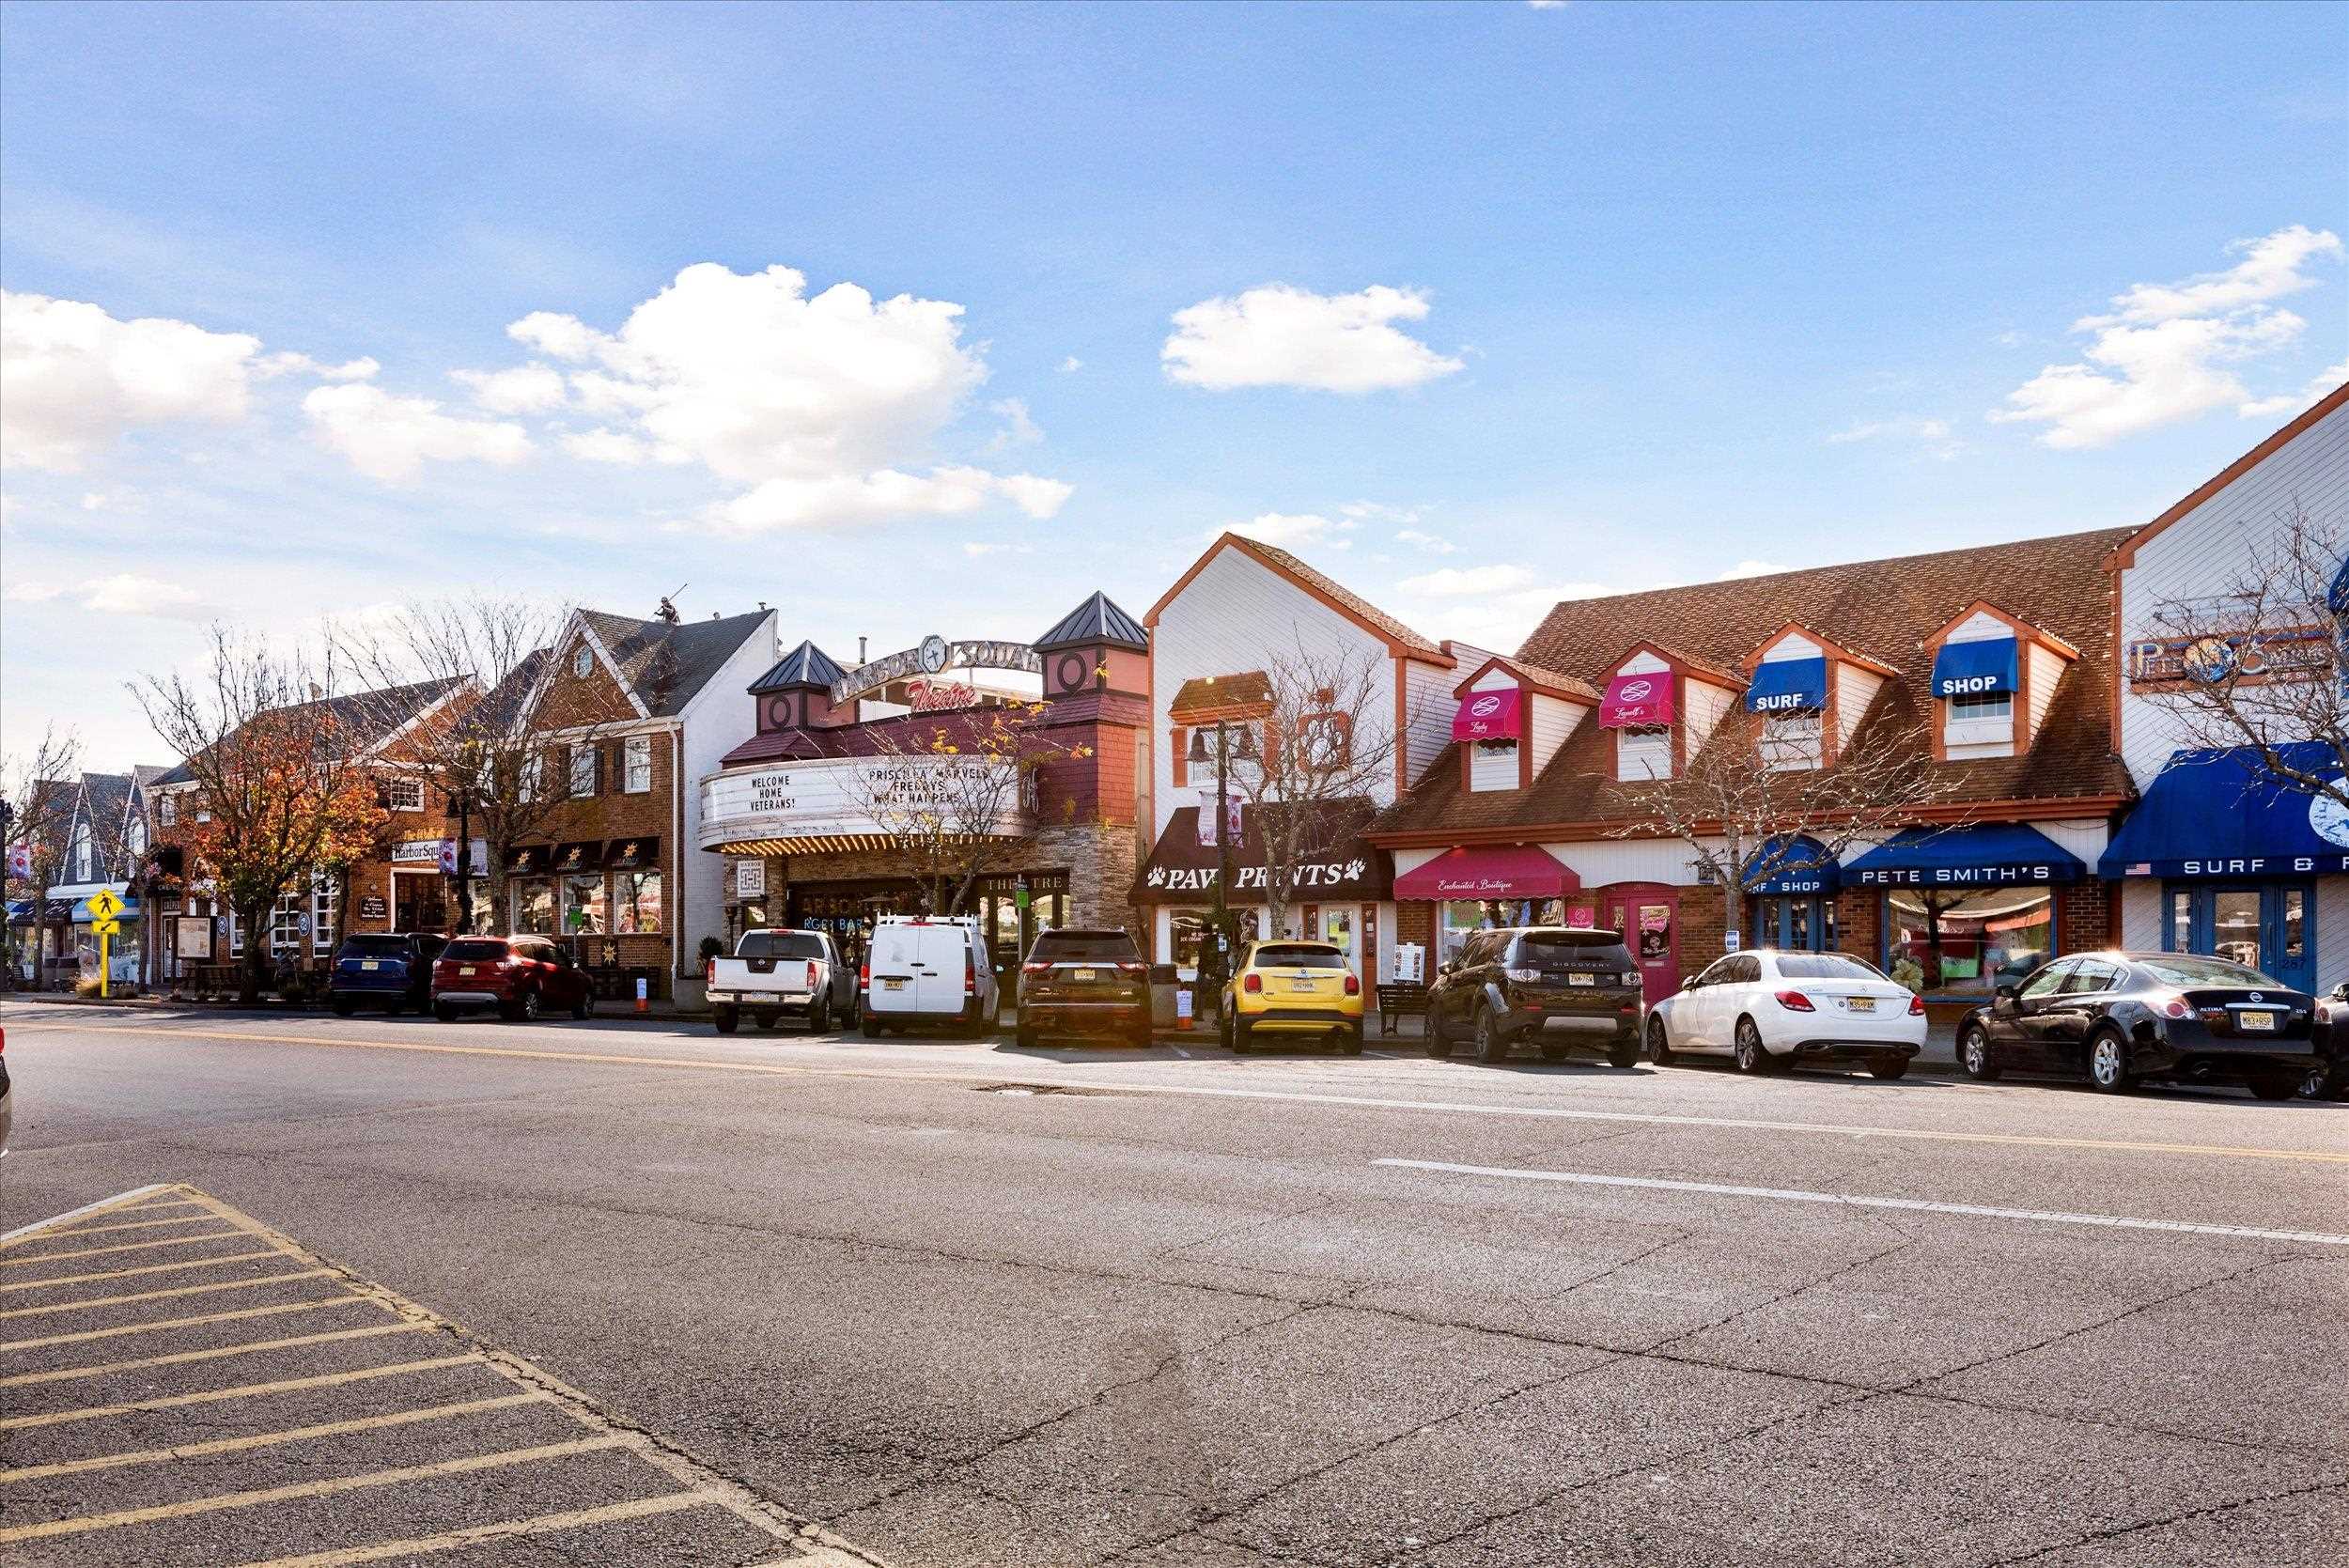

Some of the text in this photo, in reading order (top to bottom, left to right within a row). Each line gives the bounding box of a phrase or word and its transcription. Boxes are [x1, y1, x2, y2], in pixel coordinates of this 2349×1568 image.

[830, 649, 919, 704] HARBOR
[960, 642, 1043, 674] SQUAR
[1942, 675, 1998, 694] SHOP
[905, 678, 980, 712] Theatre
[1756, 692, 1803, 710] SURF
[1470, 722, 1488, 734] Lady
[752, 775, 790, 788] WELCOME
[759, 787, 783, 799] HOME
[751, 799, 795, 811] VETERANS!
[395, 844, 440, 860] Harbor Squ
[2184, 857, 2314, 875] SURF &
[1165, 868, 1220, 890] PAW
[1862, 866, 2049, 883] PETE SMITH'S
[987, 877, 1063, 890] THETRE
[1438, 878, 1513, 893] Enchanted Boutique
[1781, 881, 1821, 892] SHOP
[839, 918, 863, 930] BAR
